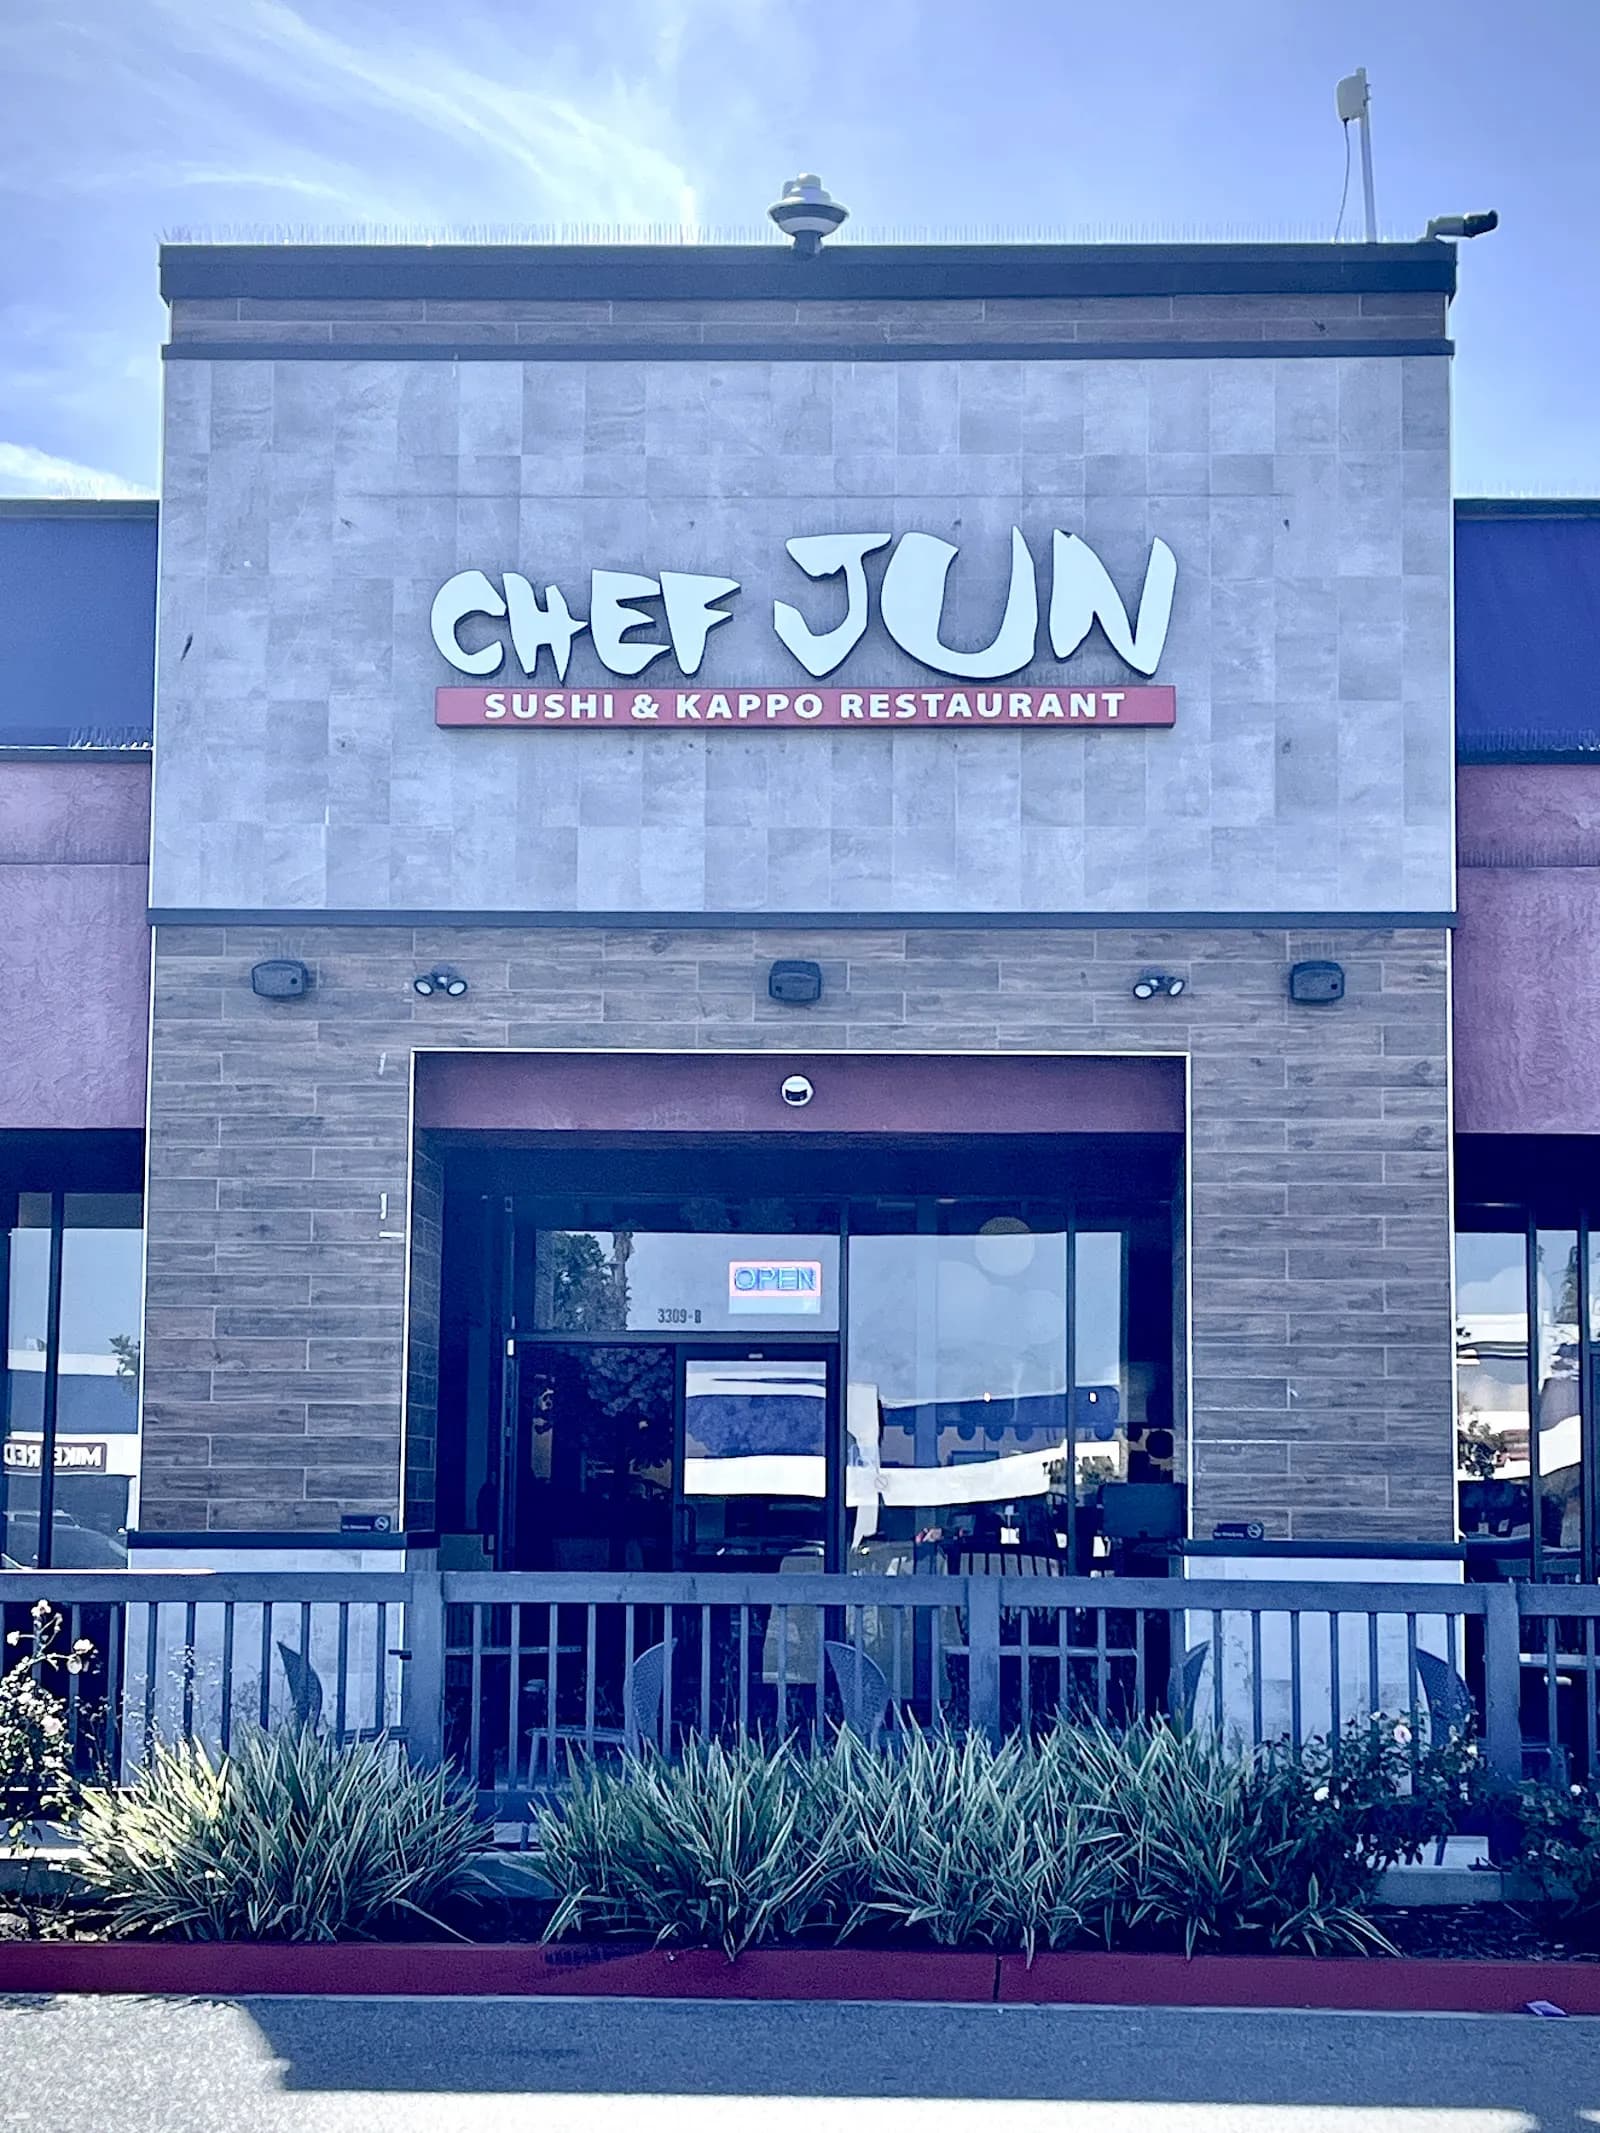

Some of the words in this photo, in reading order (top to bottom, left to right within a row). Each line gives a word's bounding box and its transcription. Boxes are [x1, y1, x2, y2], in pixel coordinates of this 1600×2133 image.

[430, 568, 742, 684] CHEF
[773, 524, 1178, 679] JUN
[484, 693, 614, 719] SUSHI
[631, 694, 659, 719] &
[676, 693, 824, 719] KAPPO
[840, 692, 1125, 718] RESTAURANT
[734, 1266, 817, 1291] OPEN
